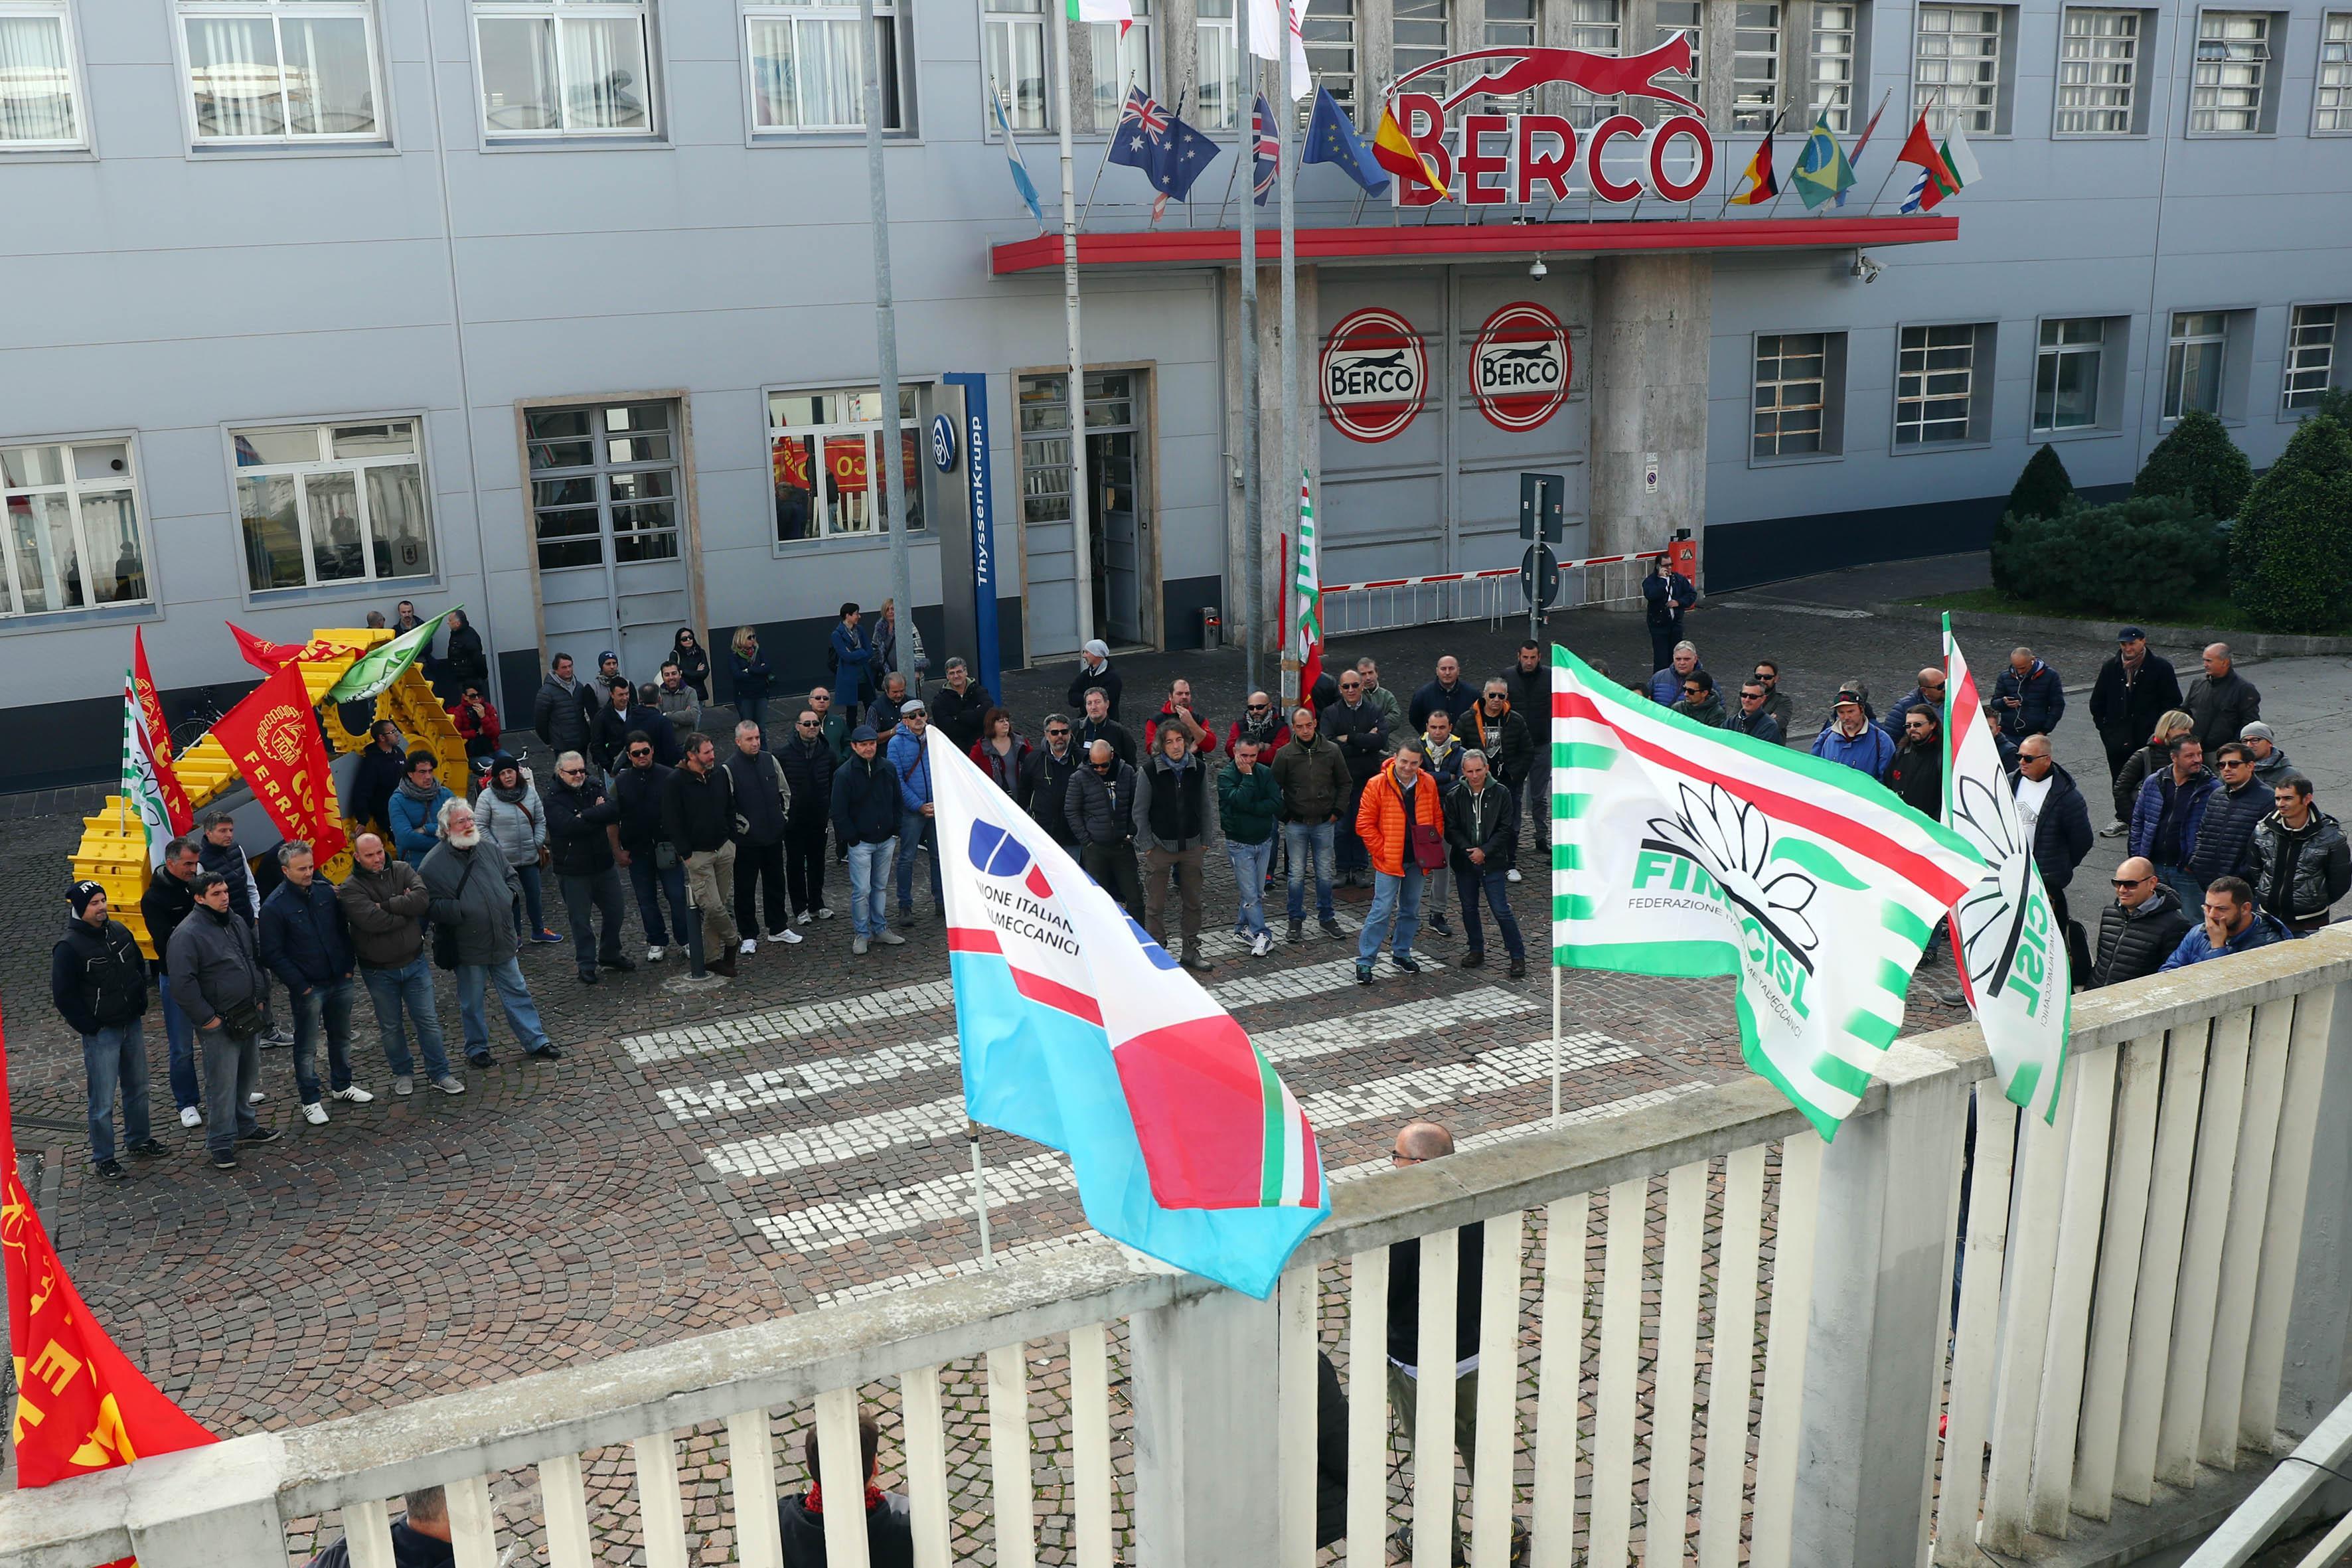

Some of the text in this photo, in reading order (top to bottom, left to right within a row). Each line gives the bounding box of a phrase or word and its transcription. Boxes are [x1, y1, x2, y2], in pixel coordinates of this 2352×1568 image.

[1393, 92, 1715, 206] BERCO
[1332, 366, 1414, 396] BERCO
[1482, 357, 1559, 386] BERCO
[971, 416, 988, 586] ThyssenKrupp
[274, 736, 295, 764] FIOM
[1016, 897, 1073, 934] ITALIAN
[1628, 897, 1723, 916] FEDERAZIONE
[1740, 916, 1810, 1020] CISL
